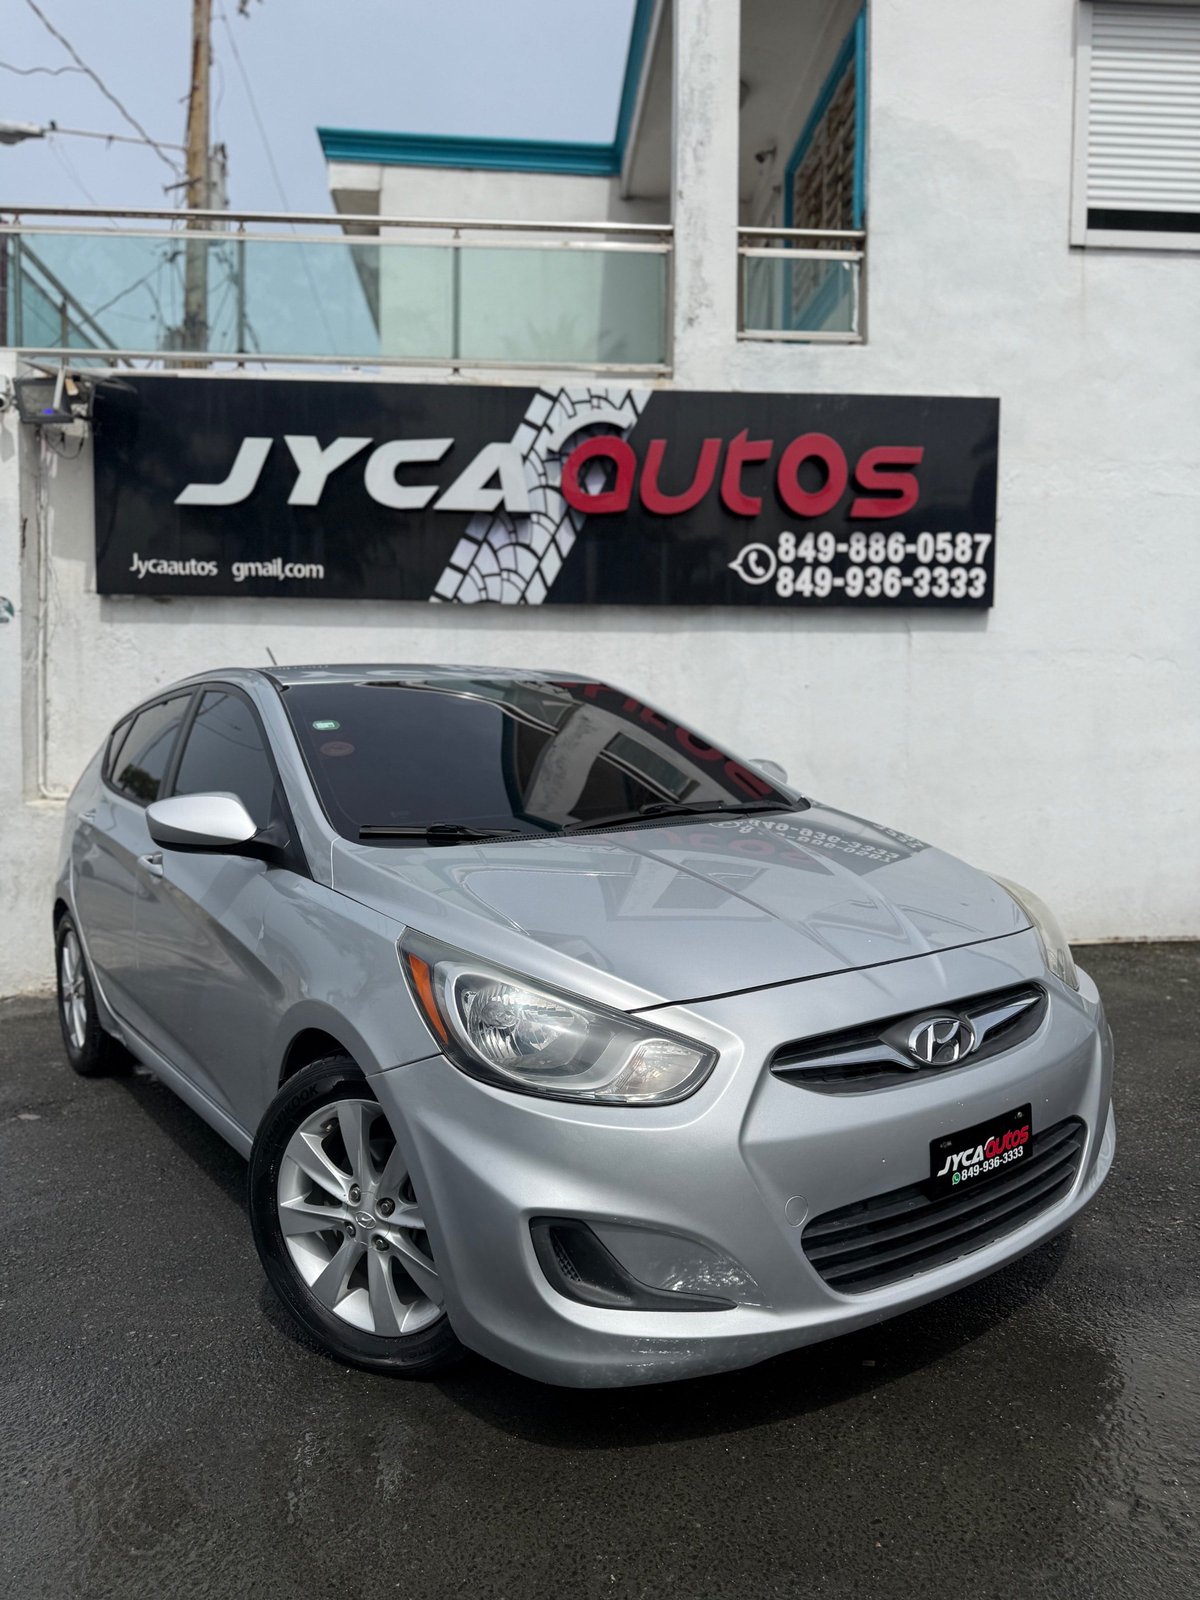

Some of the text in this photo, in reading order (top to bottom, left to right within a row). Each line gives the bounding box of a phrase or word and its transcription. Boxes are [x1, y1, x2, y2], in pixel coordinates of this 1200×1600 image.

[173, 435, 531, 513] JYCA
[777, 531, 992, 564] 849-886-0587
[129, 552, 218, 579] Jycaautos
[775, 565, 987, 598] 849-936-3333
[937, 1145, 984, 1177] JYCA
[961, 1145, 1023, 1181] 849-936-3333
